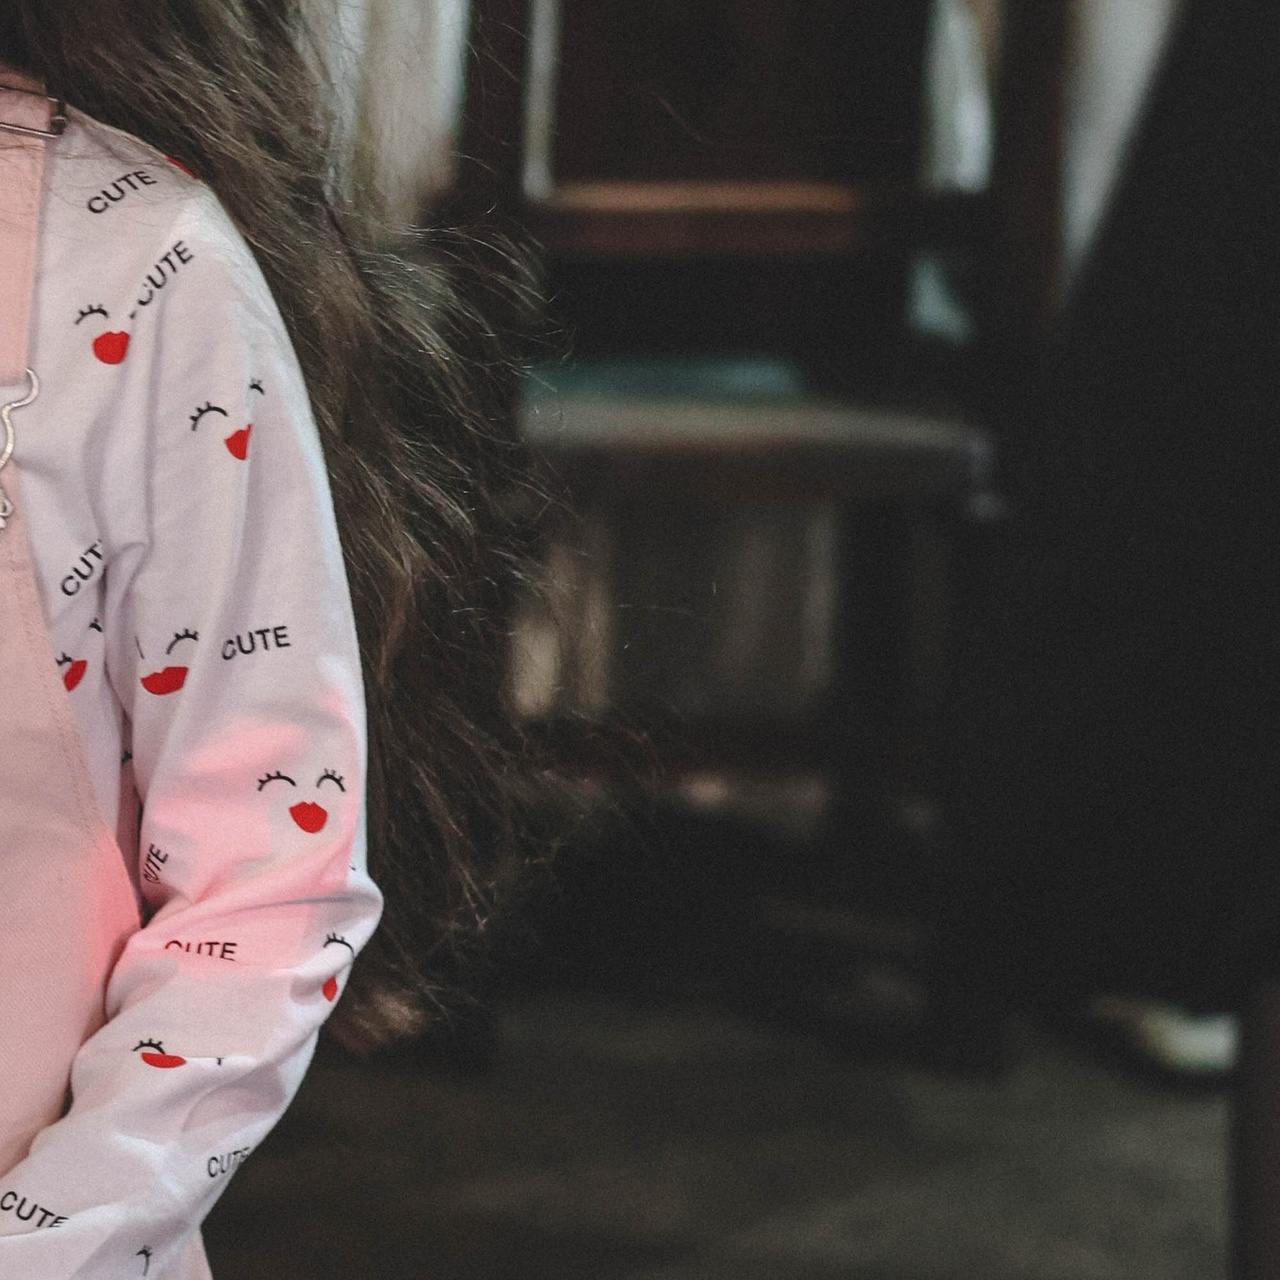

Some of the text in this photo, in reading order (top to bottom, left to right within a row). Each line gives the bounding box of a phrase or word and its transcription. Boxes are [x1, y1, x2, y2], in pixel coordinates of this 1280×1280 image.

[87, 170, 158, 214] CUTE
[137, 239, 195, 307] CUTE
[61, 538, 103, 597] CUT
[221, 624, 291, 661] CUTE
[0, 1190, 69, 1228] CUTE
